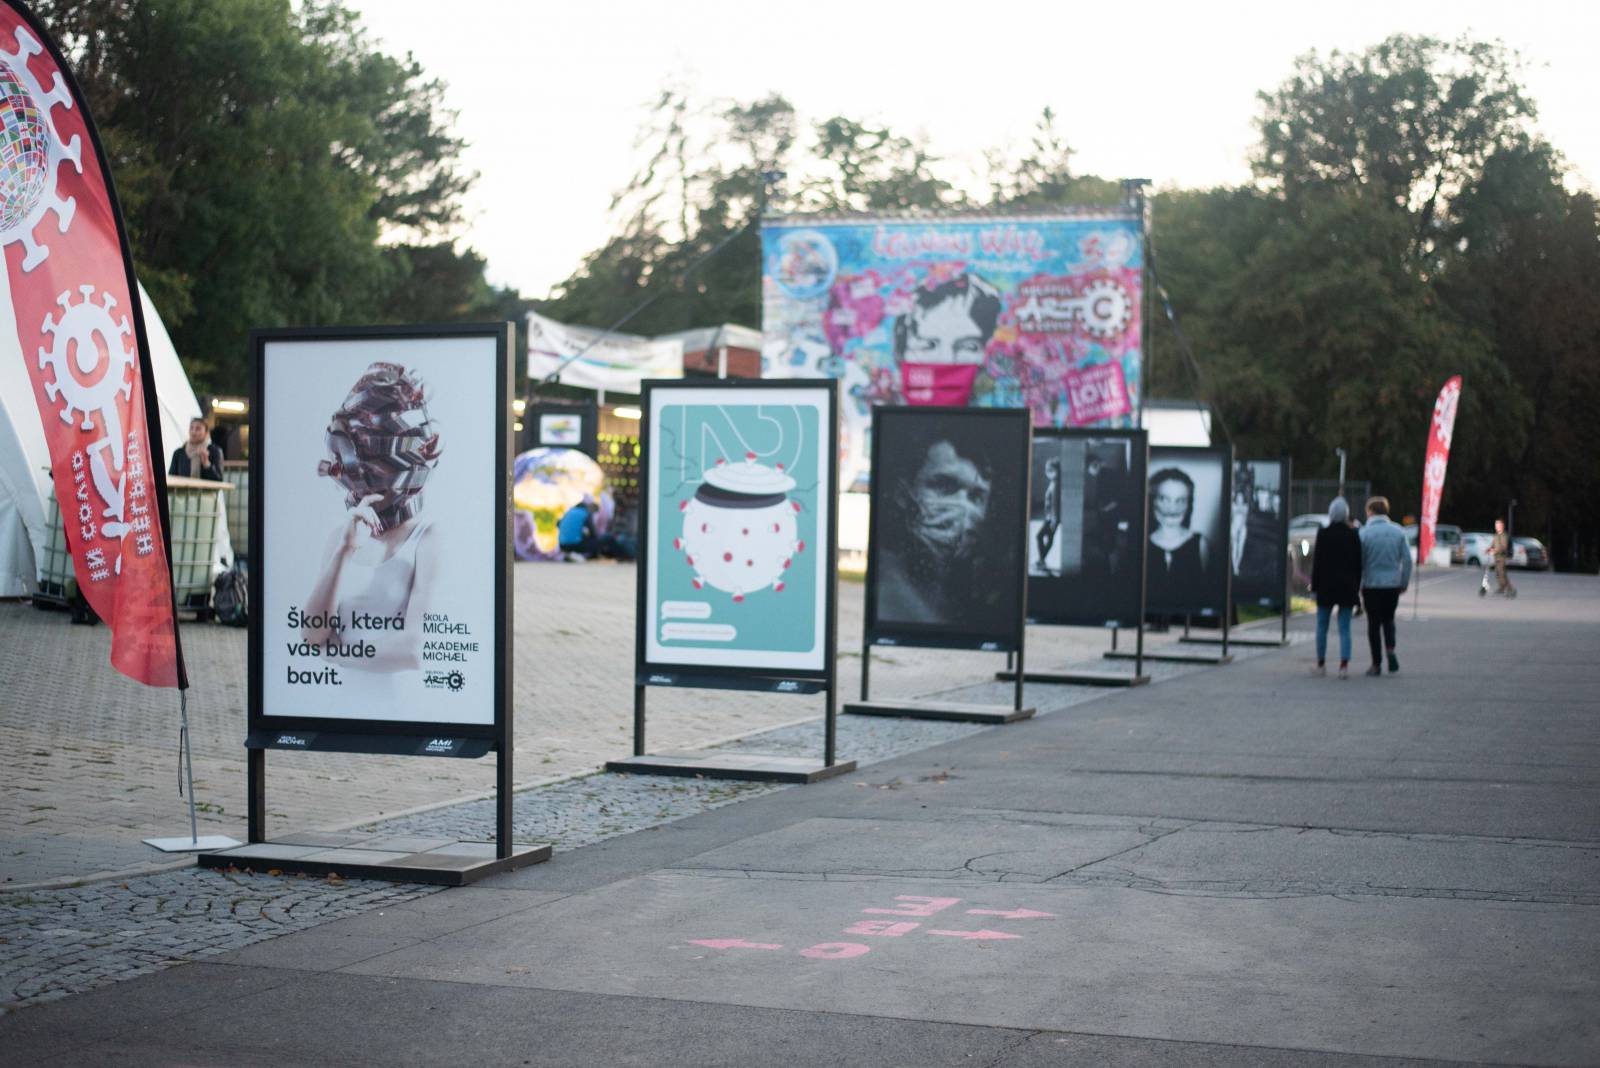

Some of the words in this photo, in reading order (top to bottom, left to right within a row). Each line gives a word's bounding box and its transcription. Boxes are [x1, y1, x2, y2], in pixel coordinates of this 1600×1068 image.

[1070, 375, 1123, 409] LOVE
[287, 606, 346, 632] Škola,
[351, 610, 405, 631] která
[423, 612, 449, 622] ŠKOLA
[287, 638, 321, 657] vás
[326, 639, 376, 658] bude
[423, 641, 480, 652] AKADEMIE
[287, 666, 343, 685] bavit.
